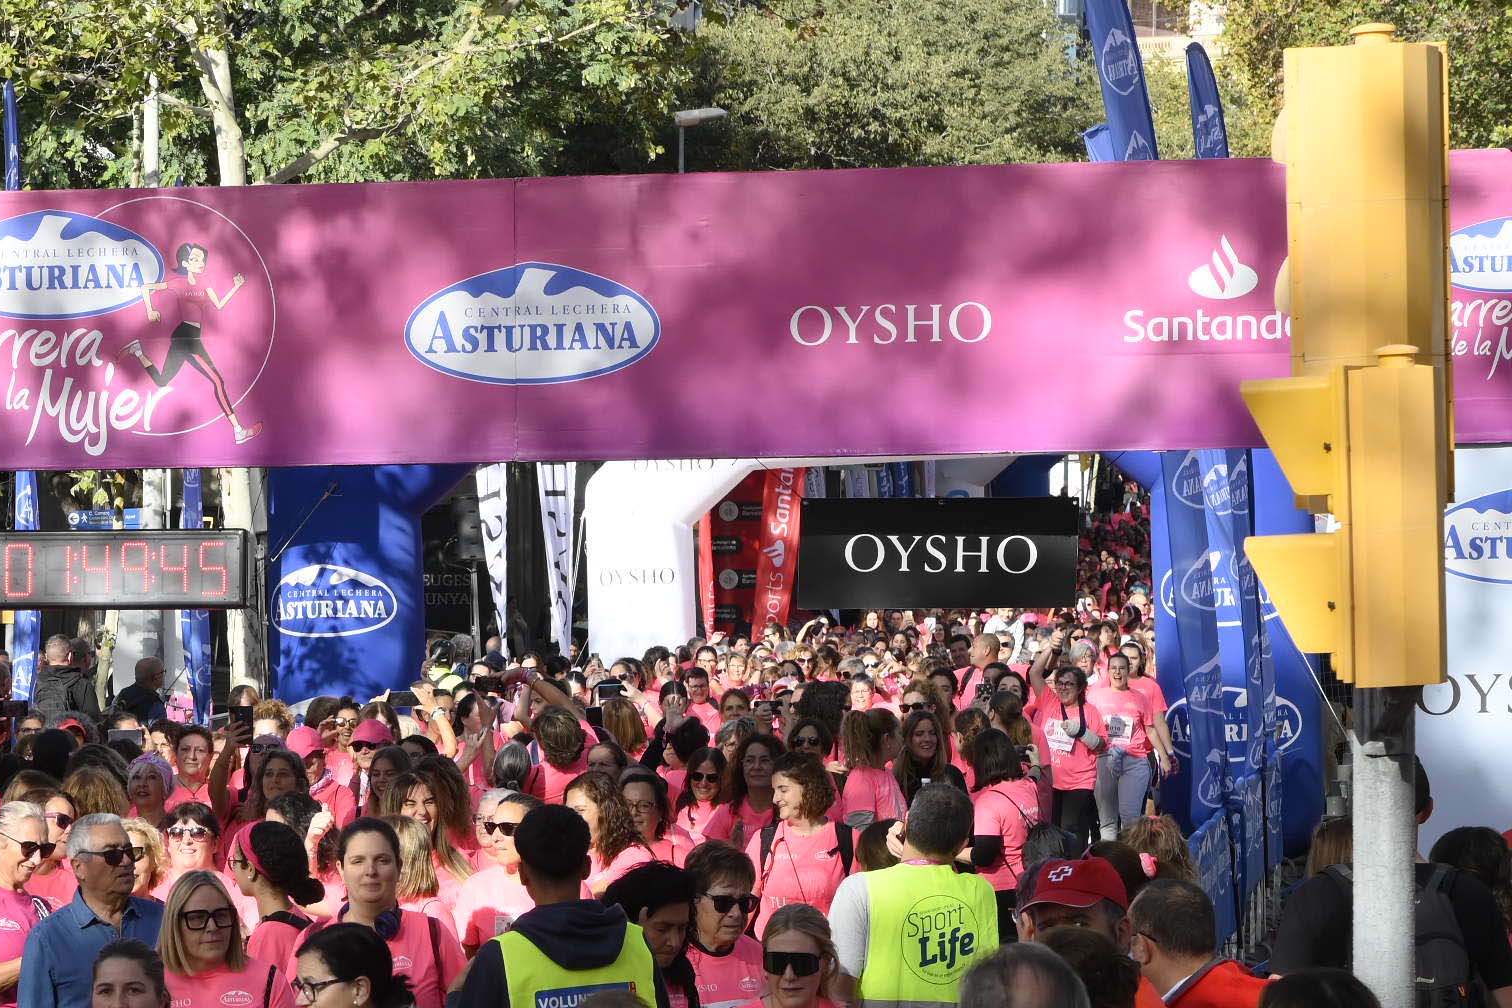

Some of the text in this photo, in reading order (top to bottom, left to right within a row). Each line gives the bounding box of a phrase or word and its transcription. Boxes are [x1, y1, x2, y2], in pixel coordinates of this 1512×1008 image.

[464, 302, 632, 319] CENTRAL LECHERA
[790, 302, 993, 346] OYSHO
[424, 310, 641, 354] ASTURIANA
[1474, 327, 1491, 356] la
[5, 369, 31, 411] la
[25, 362, 174, 456] Mujer
[4, 541, 229, 597] 01:49:45
[844, 534, 1038, 574] OYSHO
[599, 567, 676, 586] OYSHO
[276, 594, 388, 621] ASTURIANA
[908, 904, 964, 938] Sport
[919, 927, 974, 969] Life
